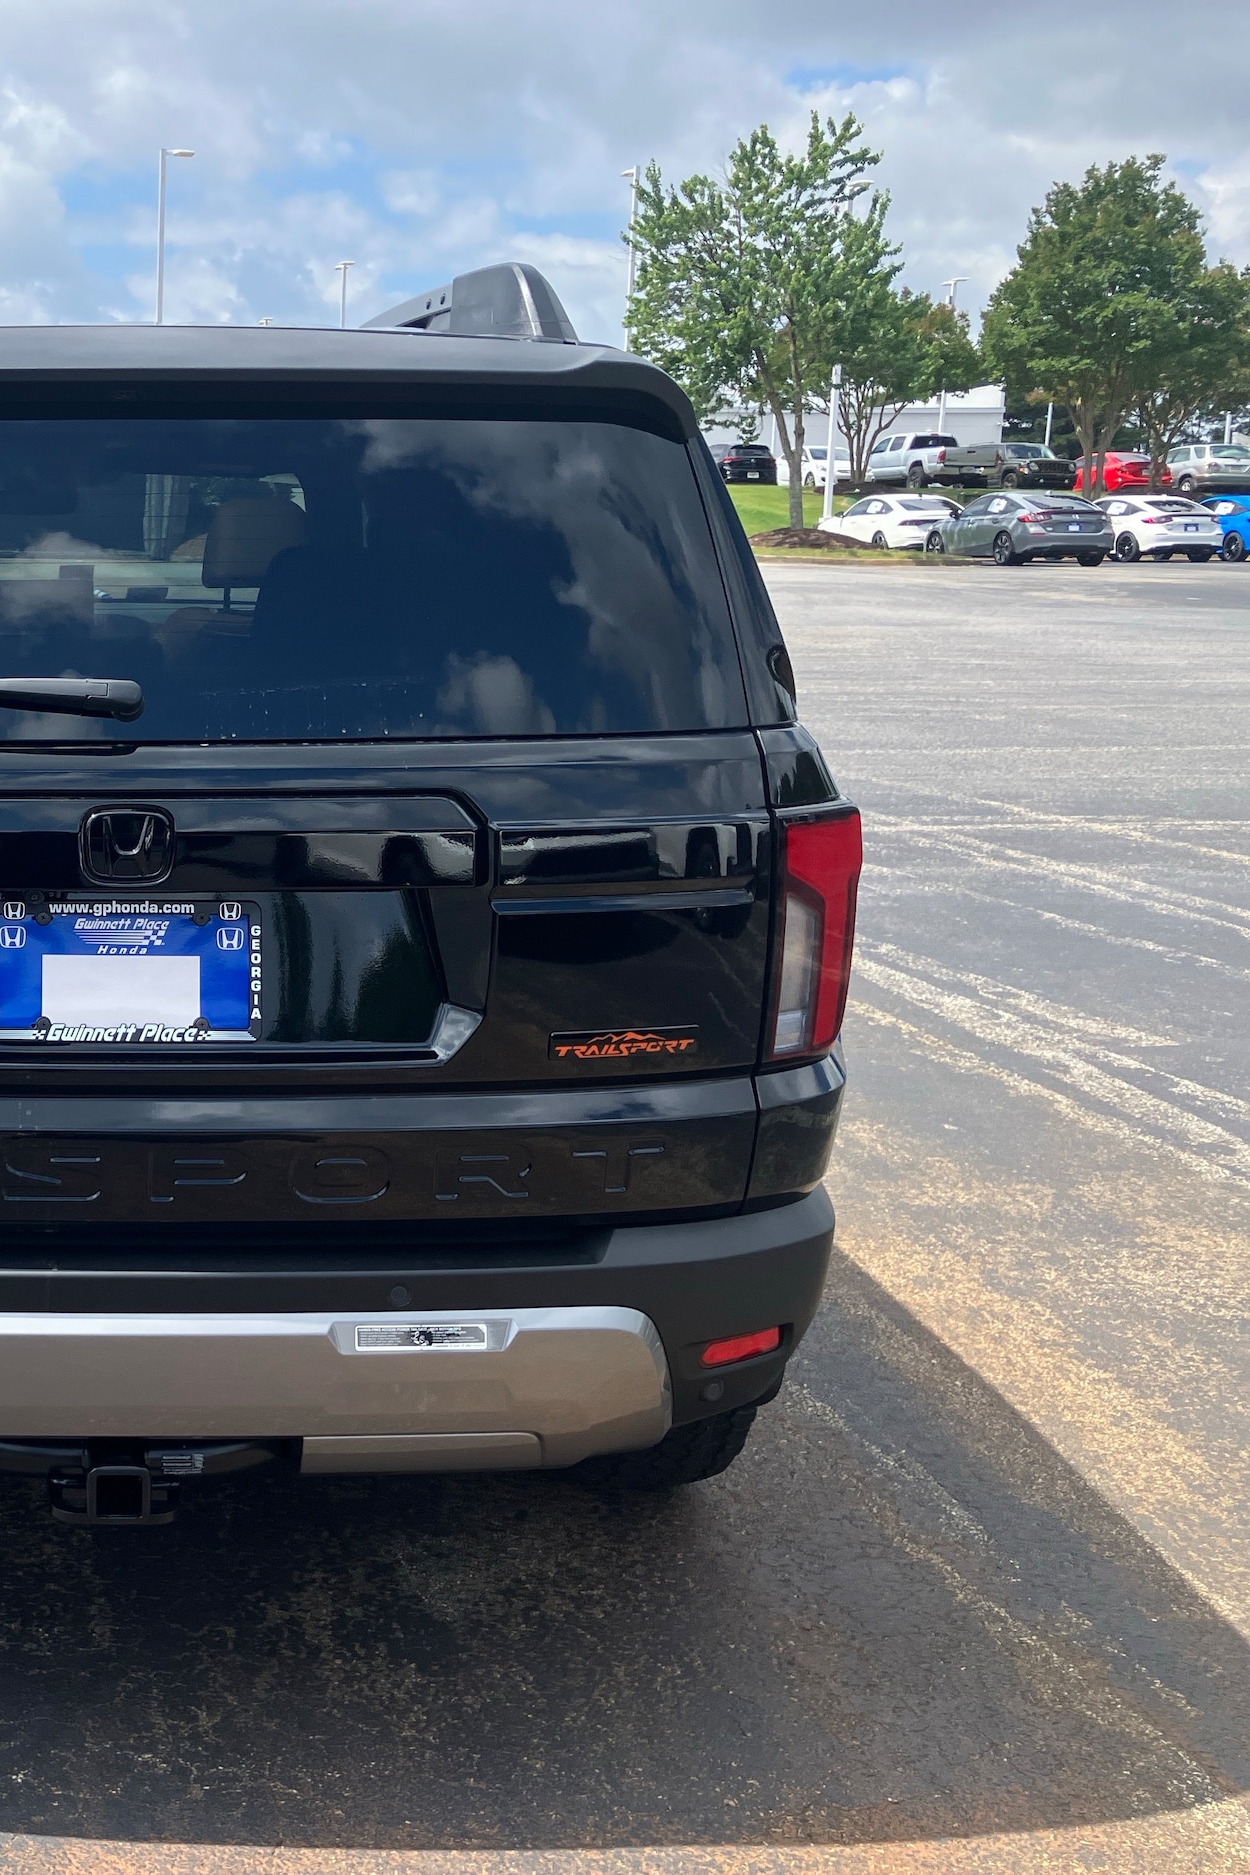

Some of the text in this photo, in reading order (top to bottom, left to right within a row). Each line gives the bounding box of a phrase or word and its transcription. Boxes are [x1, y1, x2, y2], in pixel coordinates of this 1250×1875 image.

[49, 901, 195, 916] www.gphonda.com
[74, 918, 170, 930] Gwinnett Place
[97, 945, 148, 954] Honda
[250, 925, 262, 1019] GEORGIA
[46, 1023, 198, 1042] Gwinnett Place
[554, 1038, 695, 1059] TRAILSPORT
